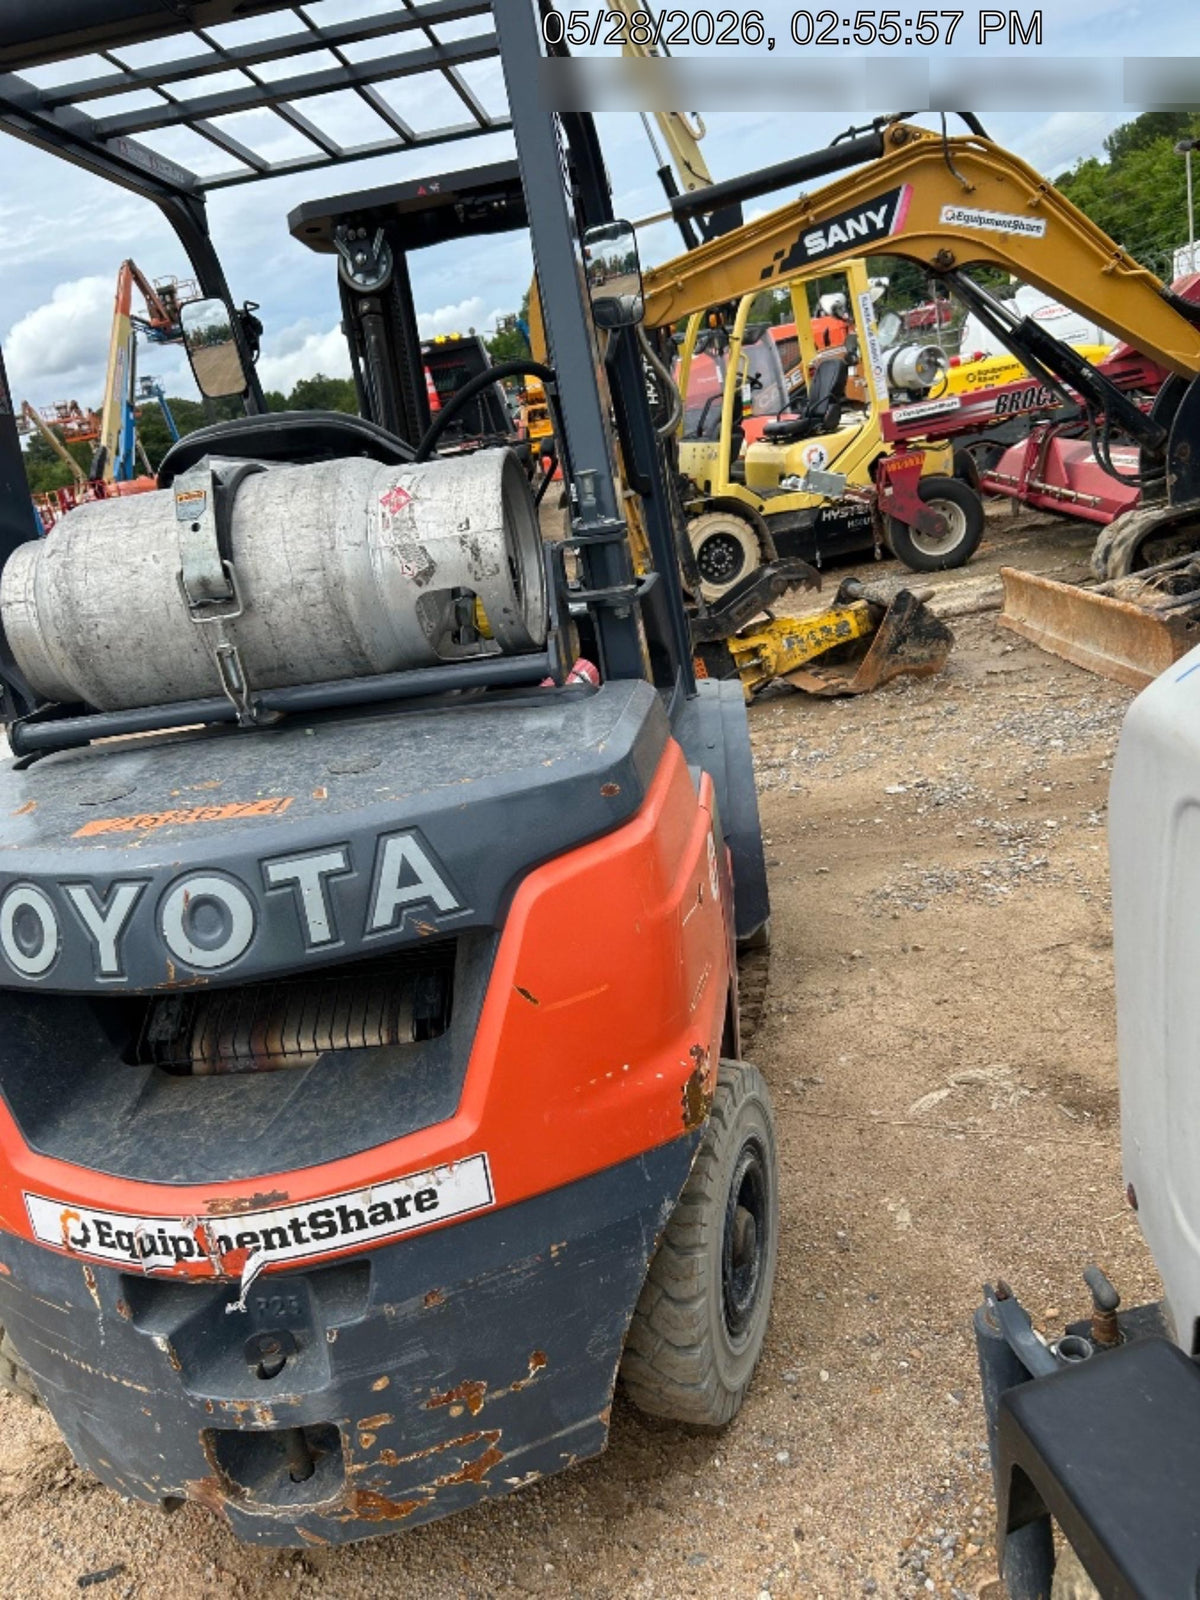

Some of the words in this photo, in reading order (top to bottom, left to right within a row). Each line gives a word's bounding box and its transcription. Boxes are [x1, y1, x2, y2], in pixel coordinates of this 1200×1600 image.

[803, 204, 888, 256] SANY
[956, 210, 1043, 236] EquipmentShare
[0, 827, 461, 978] OYOTA
